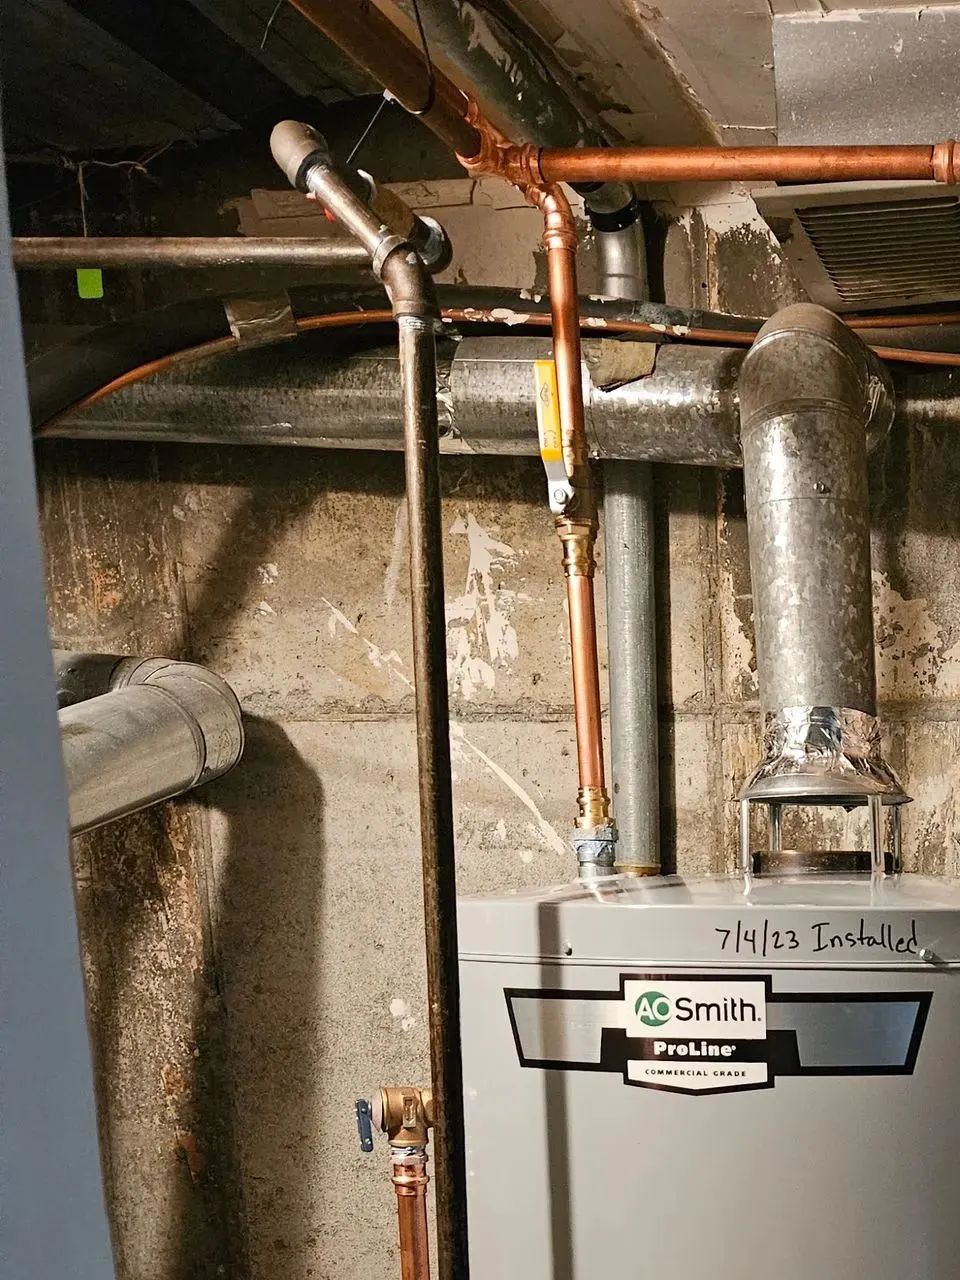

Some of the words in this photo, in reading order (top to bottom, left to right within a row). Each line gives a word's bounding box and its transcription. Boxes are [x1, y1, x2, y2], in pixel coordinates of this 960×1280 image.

[714, 919, 800, 957] 7/4/23
[811, 918, 918, 954] Installed
[675, 997, 757, 1021] Smith
[653, 1041, 733, 1057] ProLine
[645, 1069, 708, 1077] COMMERCIAL
